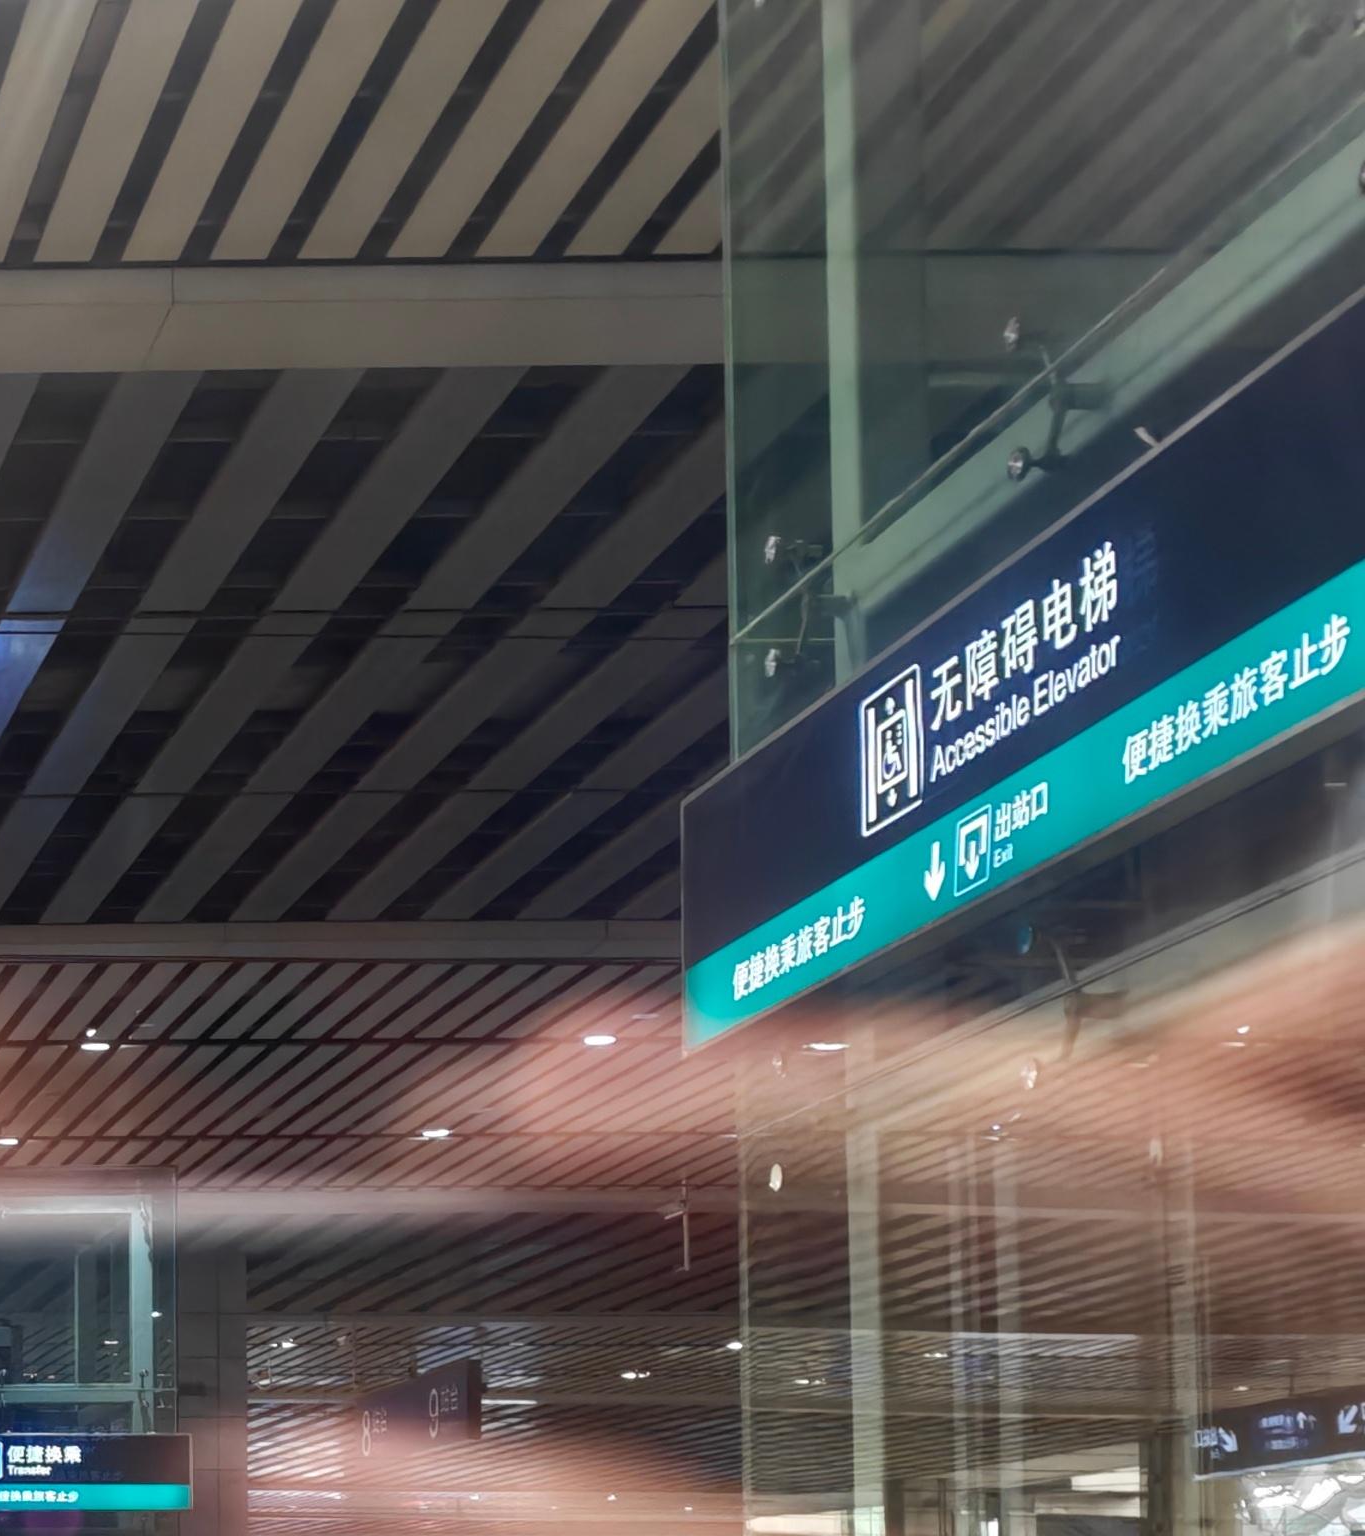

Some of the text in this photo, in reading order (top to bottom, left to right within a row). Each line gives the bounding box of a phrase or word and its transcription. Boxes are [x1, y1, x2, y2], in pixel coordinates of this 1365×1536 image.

[930, 541, 1118, 731] 无障碍电梯
[930, 635, 1121, 782] Accessible Elevator
[1122, 614, 1350, 784] 便捷换乘旅客止步
[993, 782, 1049, 841] 出站口
[992, 844, 1013, 869] Exit
[732, 896, 865, 1001] 便捷换乘旅客止步
[7, 1445, 82, 1464] 便捷换乘
[7, 1464, 52, 1477] Transfer
